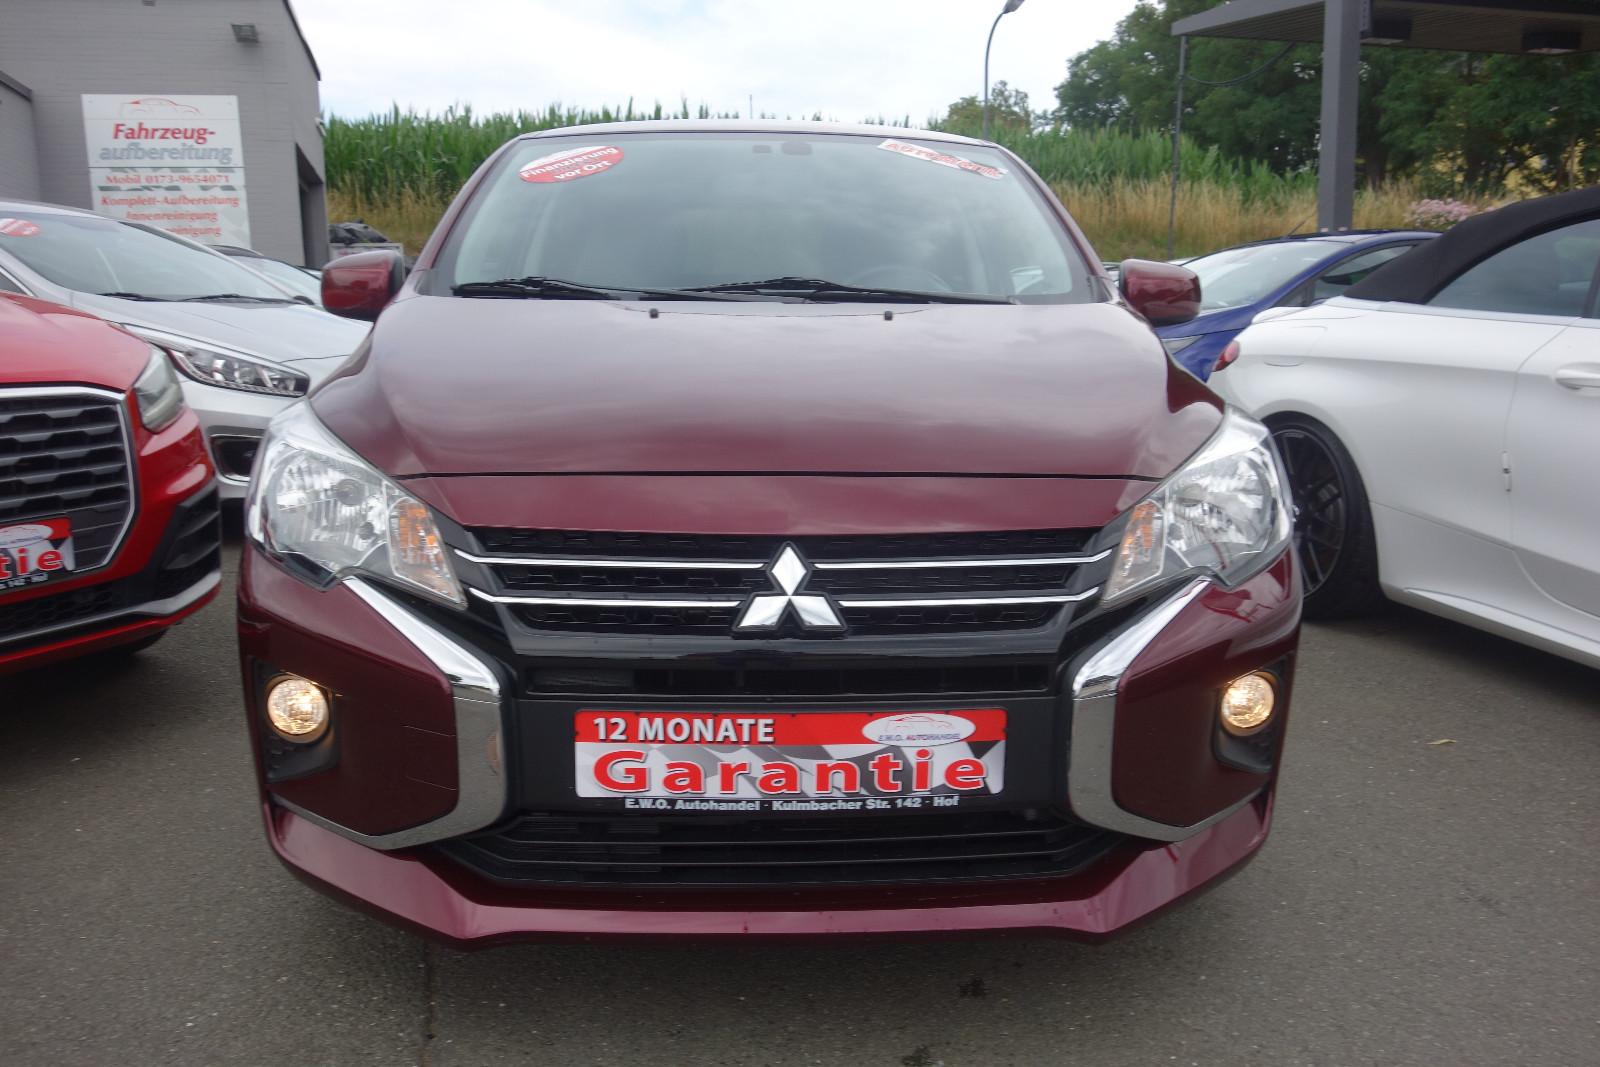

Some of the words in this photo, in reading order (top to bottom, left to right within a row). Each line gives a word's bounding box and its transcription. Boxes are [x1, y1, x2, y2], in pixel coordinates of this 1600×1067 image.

[113, 122, 216, 145] Fahrzeug-
[100, 142, 233, 165] aufbereitung
[520, 147, 619, 178] Finanzierung
[105, 174, 141, 184] Mobil
[554, 168, 583, 180] vor
[583, 160, 613, 172] Ort
[594, 717, 627, 741] 12
[638, 717, 775, 743] MONATE
[906, 732, 961, 742] AUTOHANDEL
[593, 748, 987, 794] Garantie
[625, 799, 671, 809] E.W.O.
[674, 799, 760, 811] Autohandel
[772, 799, 863, 811] Kulmbacher
[866, 799, 891, 810] Str.
[896, 798, 922, 809] 142
[933, 796, 960, 807] Hof
